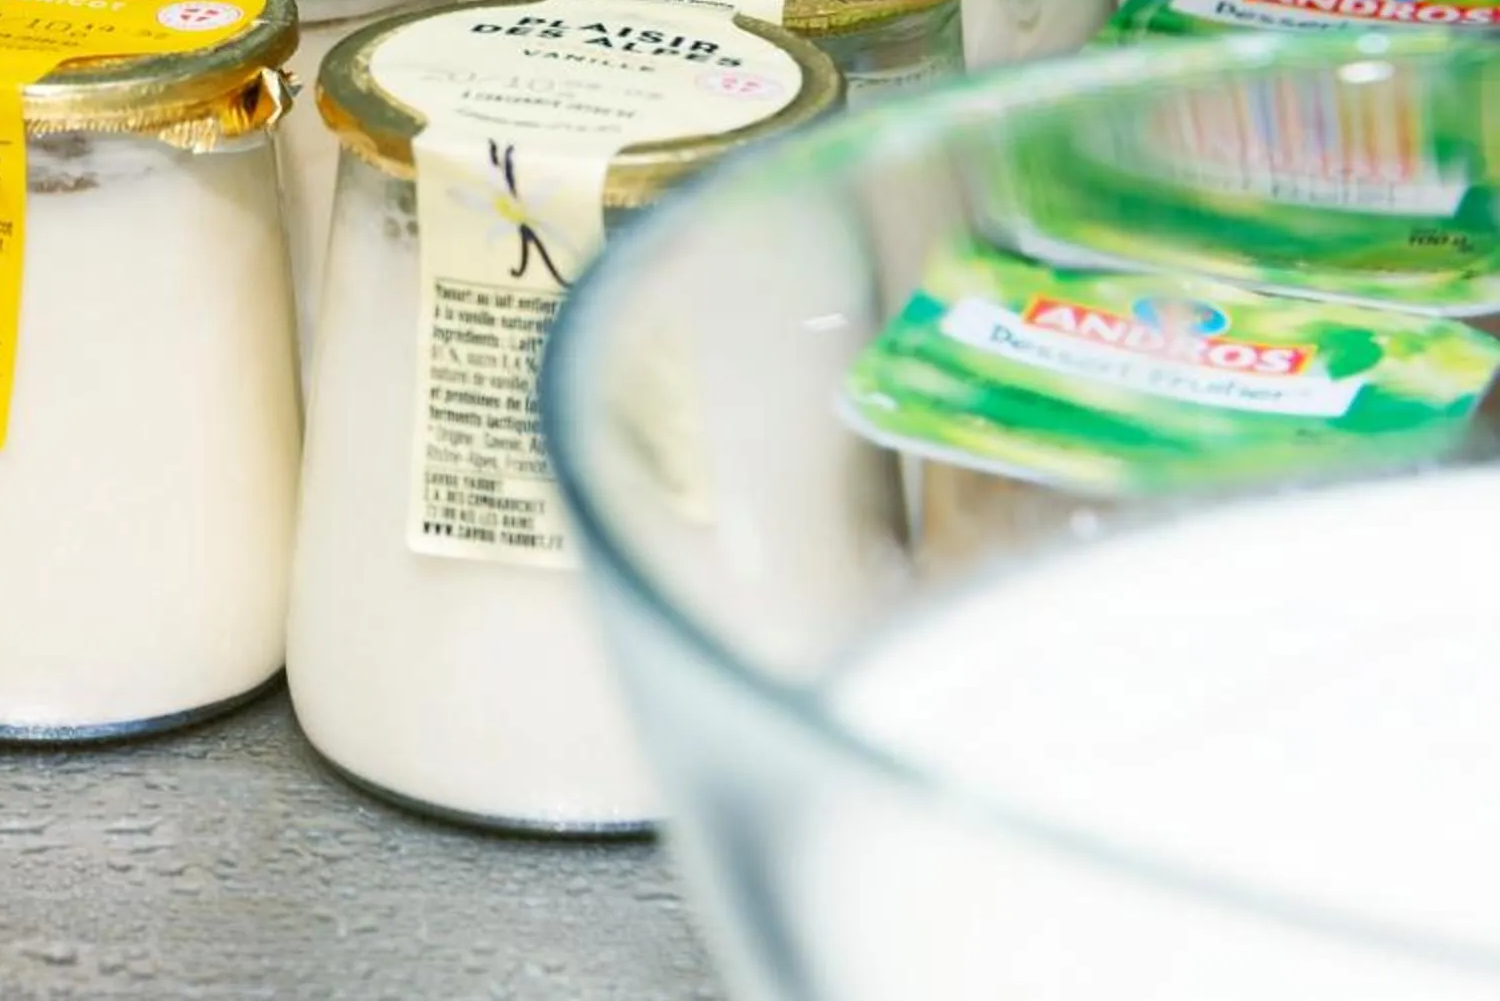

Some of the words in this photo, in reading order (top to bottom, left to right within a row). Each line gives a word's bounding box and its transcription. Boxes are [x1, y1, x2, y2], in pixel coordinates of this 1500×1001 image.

[471, 24, 563, 39] DES
[583, 37, 741, 67] ALPES
[517, 16, 719, 54] PLAISIR
[524, 49, 655, 72] VANILLE
